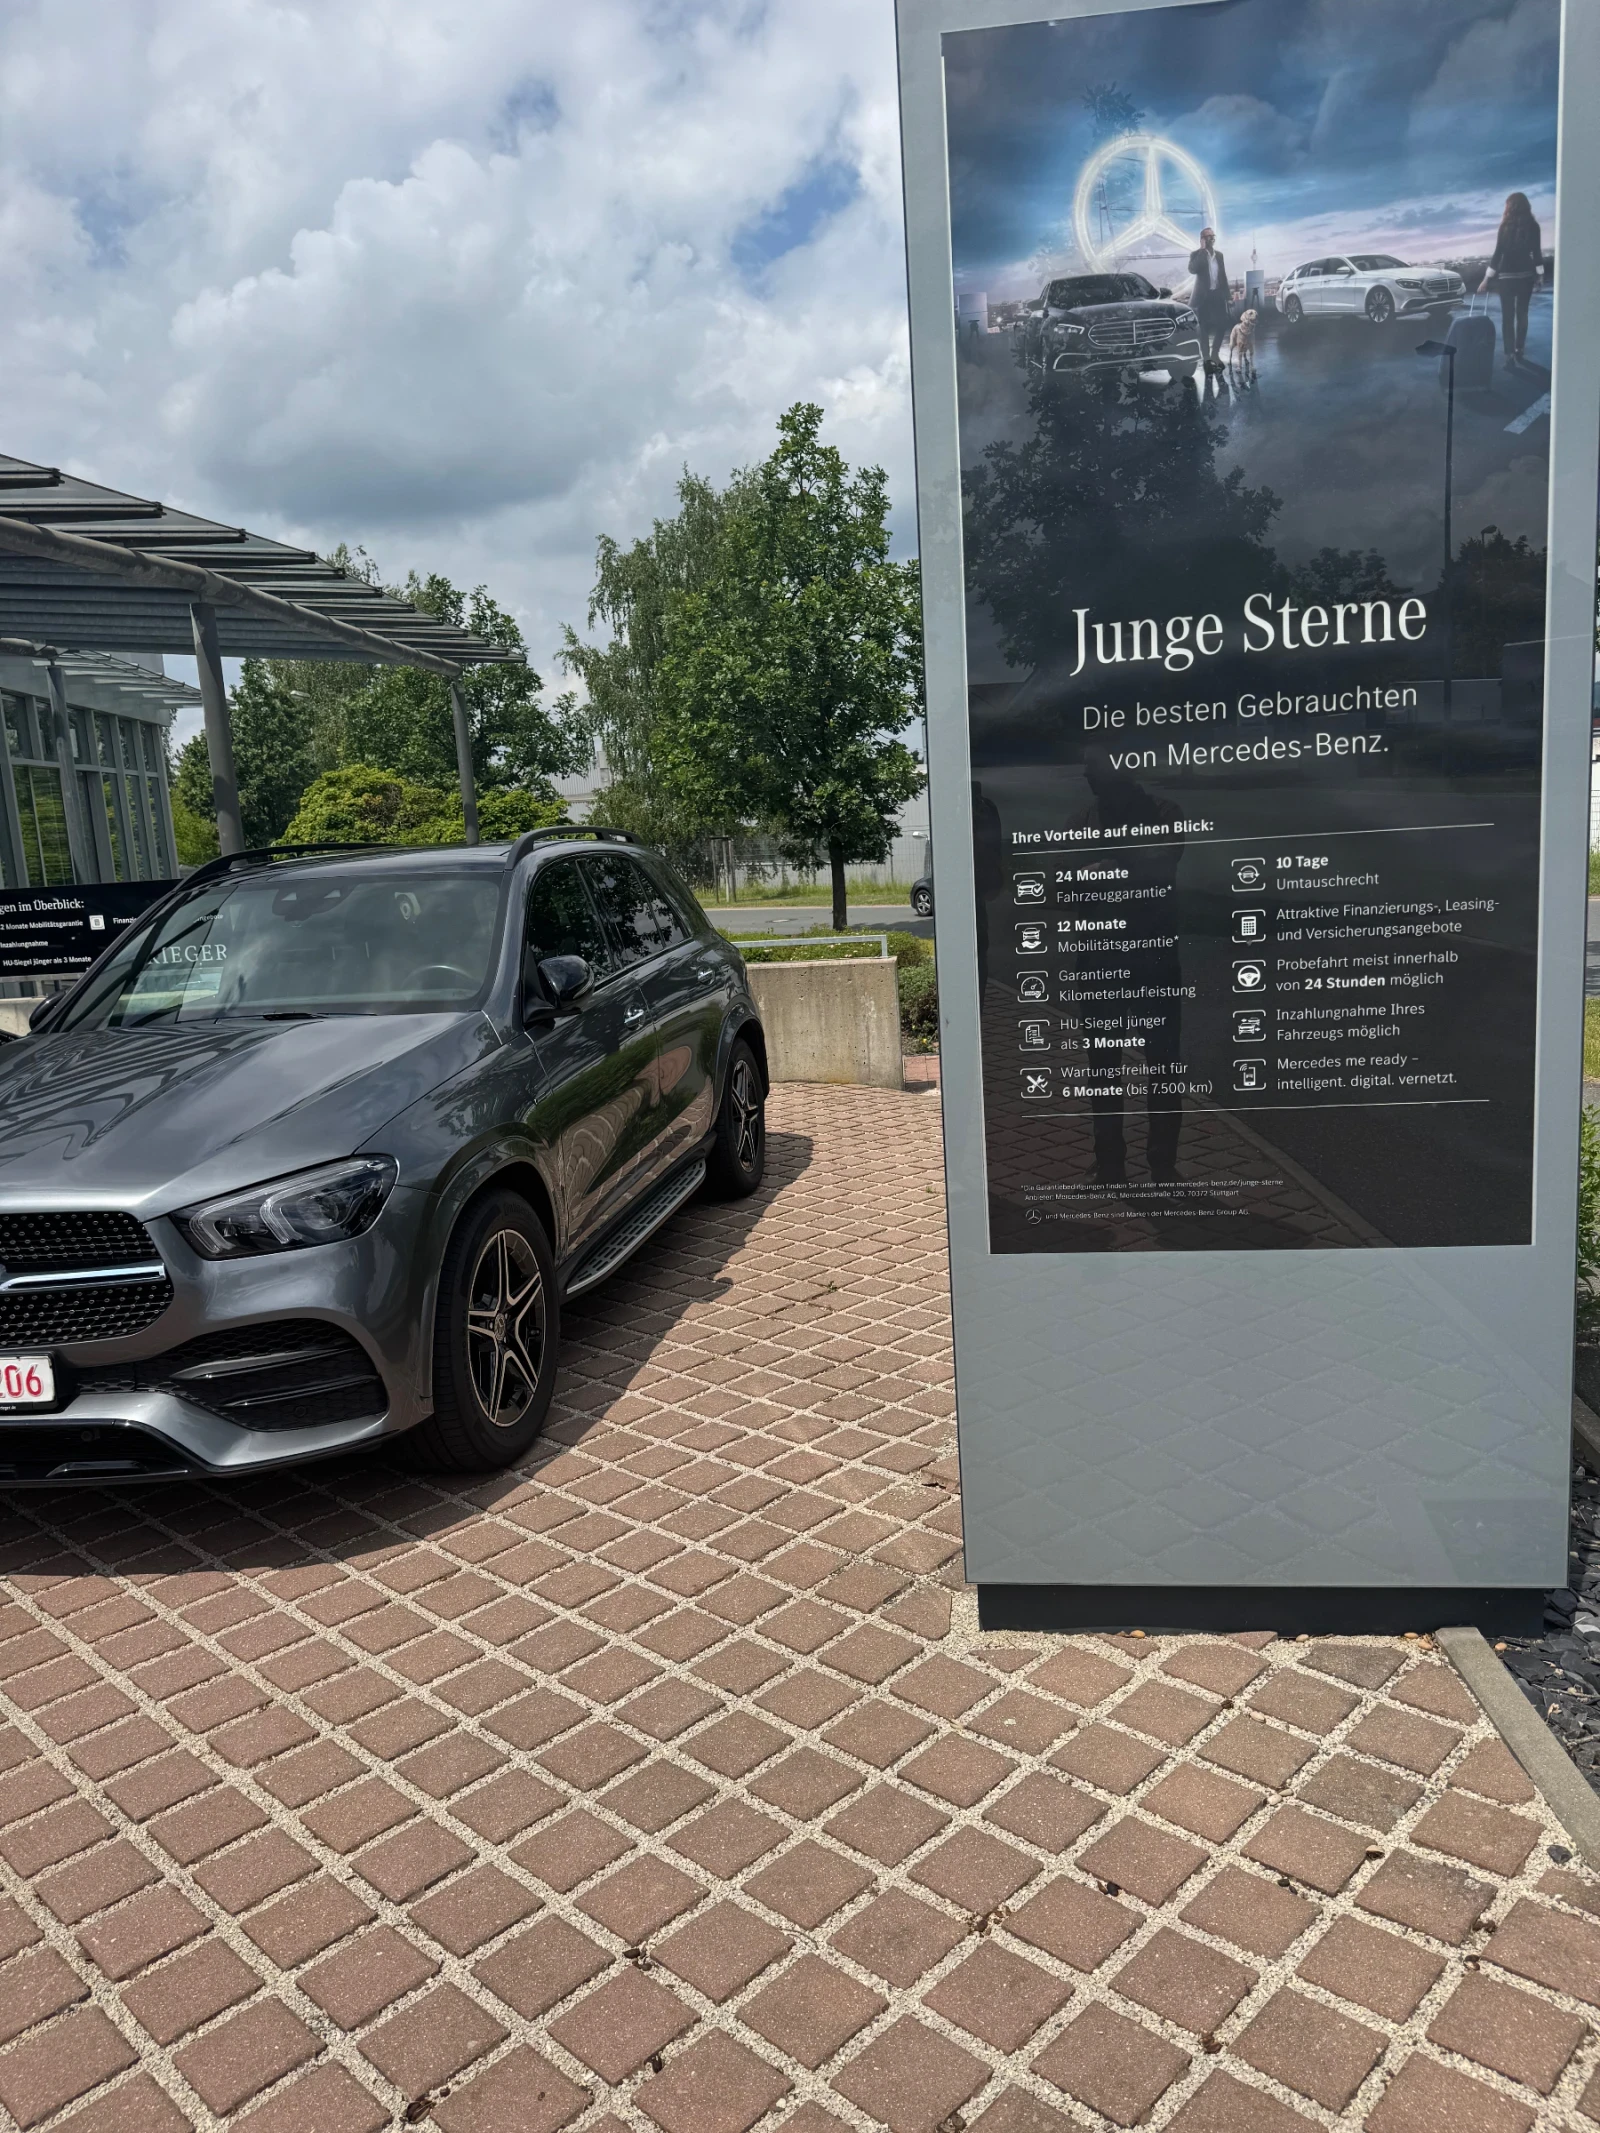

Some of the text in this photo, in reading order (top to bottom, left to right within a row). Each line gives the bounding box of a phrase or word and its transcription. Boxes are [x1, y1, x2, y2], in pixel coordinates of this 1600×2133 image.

[1070, 592, 1427, 676] Junge Sterne
[1083, 685, 1417, 730] Die besten Gebrauchten
[1110, 732, 1389, 769] von Mercedes-Benz.
[1012, 819, 1214, 844] Ihre Vorteile auf einen Blick:
[1276, 855, 1329, 870] 10 Tage
[1055, 868, 1129, 882] 24 Monate
[1276, 873, 1380, 890] Umtauschrecht
[1276, 898, 1500, 920] Attraktive Finanzierungs-, Leasing-
[1057, 918, 1127, 932] 12 Monate
[1277, 921, 1462, 941] und Versicherungsangebote
[148, 944, 227, 964] IEGER
[1277, 951, 1459, 970] Probefahrt meist innerhalb
[1059, 968, 1131, 982] Garantierte
[1276, 973, 1444, 991] von 24 Stunden möglich
[1059, 985, 1196, 1001] Kilometerlaufleistung
[1276, 1003, 1425, 1021] Inzahlungnahme Ihres
[1060, 1016, 1167, 1030] HU-Siegel jünger
[1277, 1024, 1401, 1041] Fahrzeugs möglich
[1061, 1036, 1146, 1050] als 3 Monate
[1277, 1057, 1342, 1069] Mercedes
[1346, 1056, 1366, 1067] me
[1371, 1053, 1408, 1066] ready
[1061, 1063, 1188, 1078] Wartungsfreiheit für
[1062, 1080, 1213, 1097] 6 Monate (bis 7.500 km)
[1277, 1072, 1457, 1091] intelligent. digital. vernetzt.
[0, 1364, 43, 1397] 06
